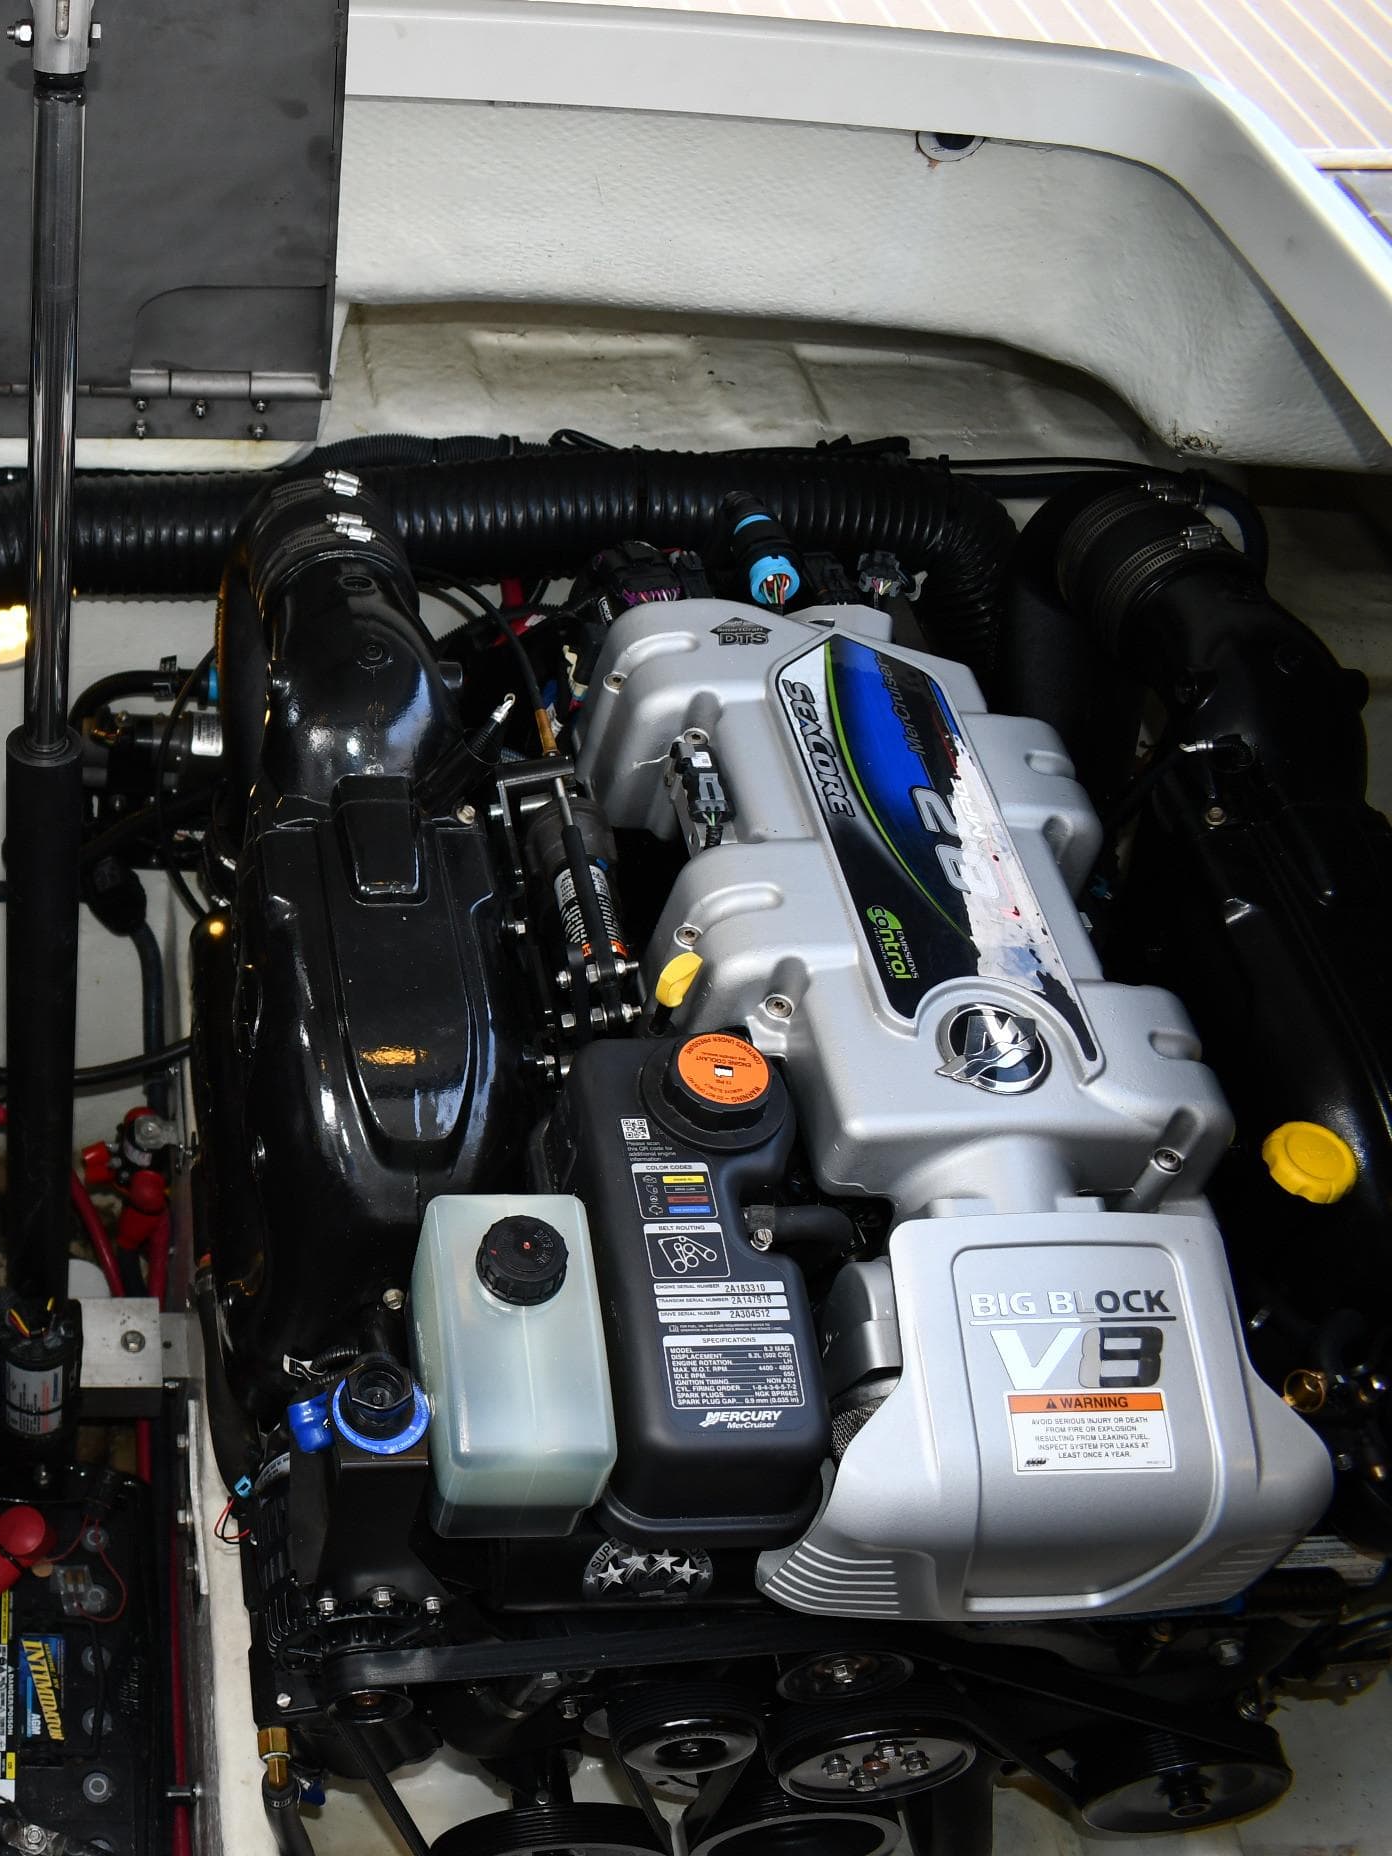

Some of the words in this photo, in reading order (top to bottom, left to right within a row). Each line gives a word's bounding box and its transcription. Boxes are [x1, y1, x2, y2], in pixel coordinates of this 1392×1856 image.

[719, 632, 769, 645] DTS
[880, 661, 926, 756] MerCruiser
[782, 679, 856, 818] SEACORE
[872, 905, 912, 979] control
[896, 930, 920, 979] EMISSIONS
[732, 1086, 762, 1103] WARNING
[970, 1292, 1036, 1317] BIG
[1047, 1289, 1171, 1314] BLOCK
[990, 1326, 1164, 1389] V8
[704, 1410, 782, 1421] MERCURY
[1061, 1396, 1129, 1409] WARNING
[1038, 1443, 1068, 1451] INSPECT
[22, 1640, 64, 1740] INTIMIDATOR
[32, 1713, 41, 1735] AGM
